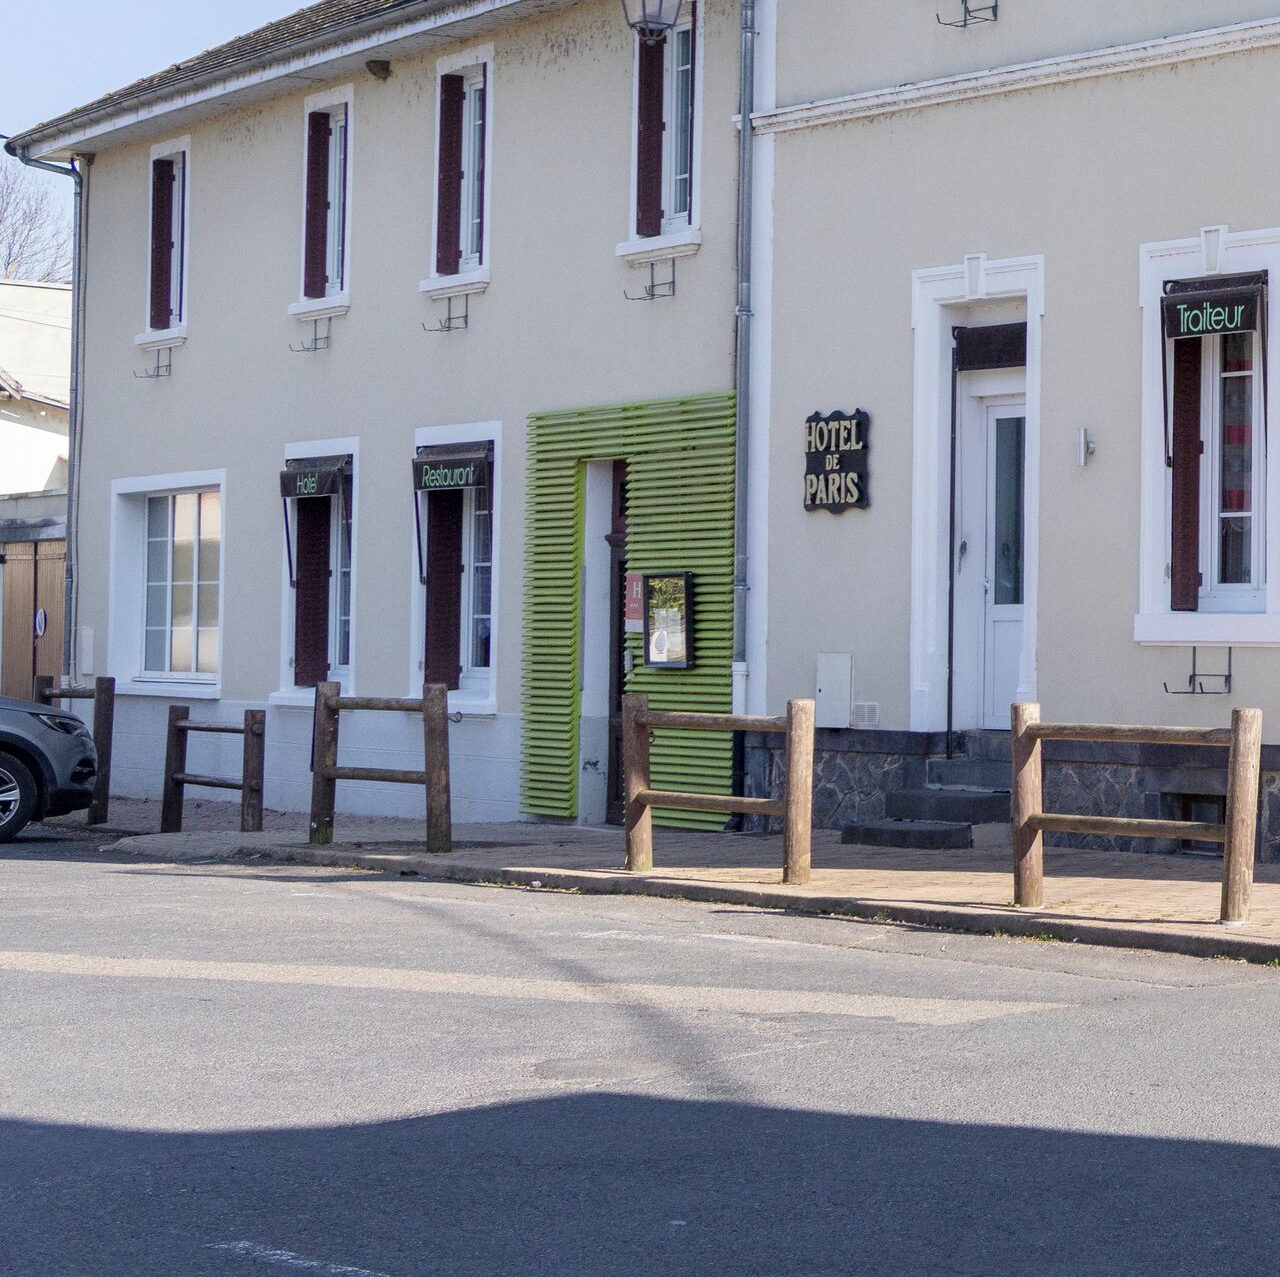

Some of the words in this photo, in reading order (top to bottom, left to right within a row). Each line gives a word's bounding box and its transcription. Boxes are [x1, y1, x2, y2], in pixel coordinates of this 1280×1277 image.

[1176, 301, 1245, 333] Traiteur
[804, 419, 864, 452] HOTEL
[422, 462, 474, 487] Restaurant
[825, 454, 840, 470] DE
[805, 472, 860, 504] PARIS
